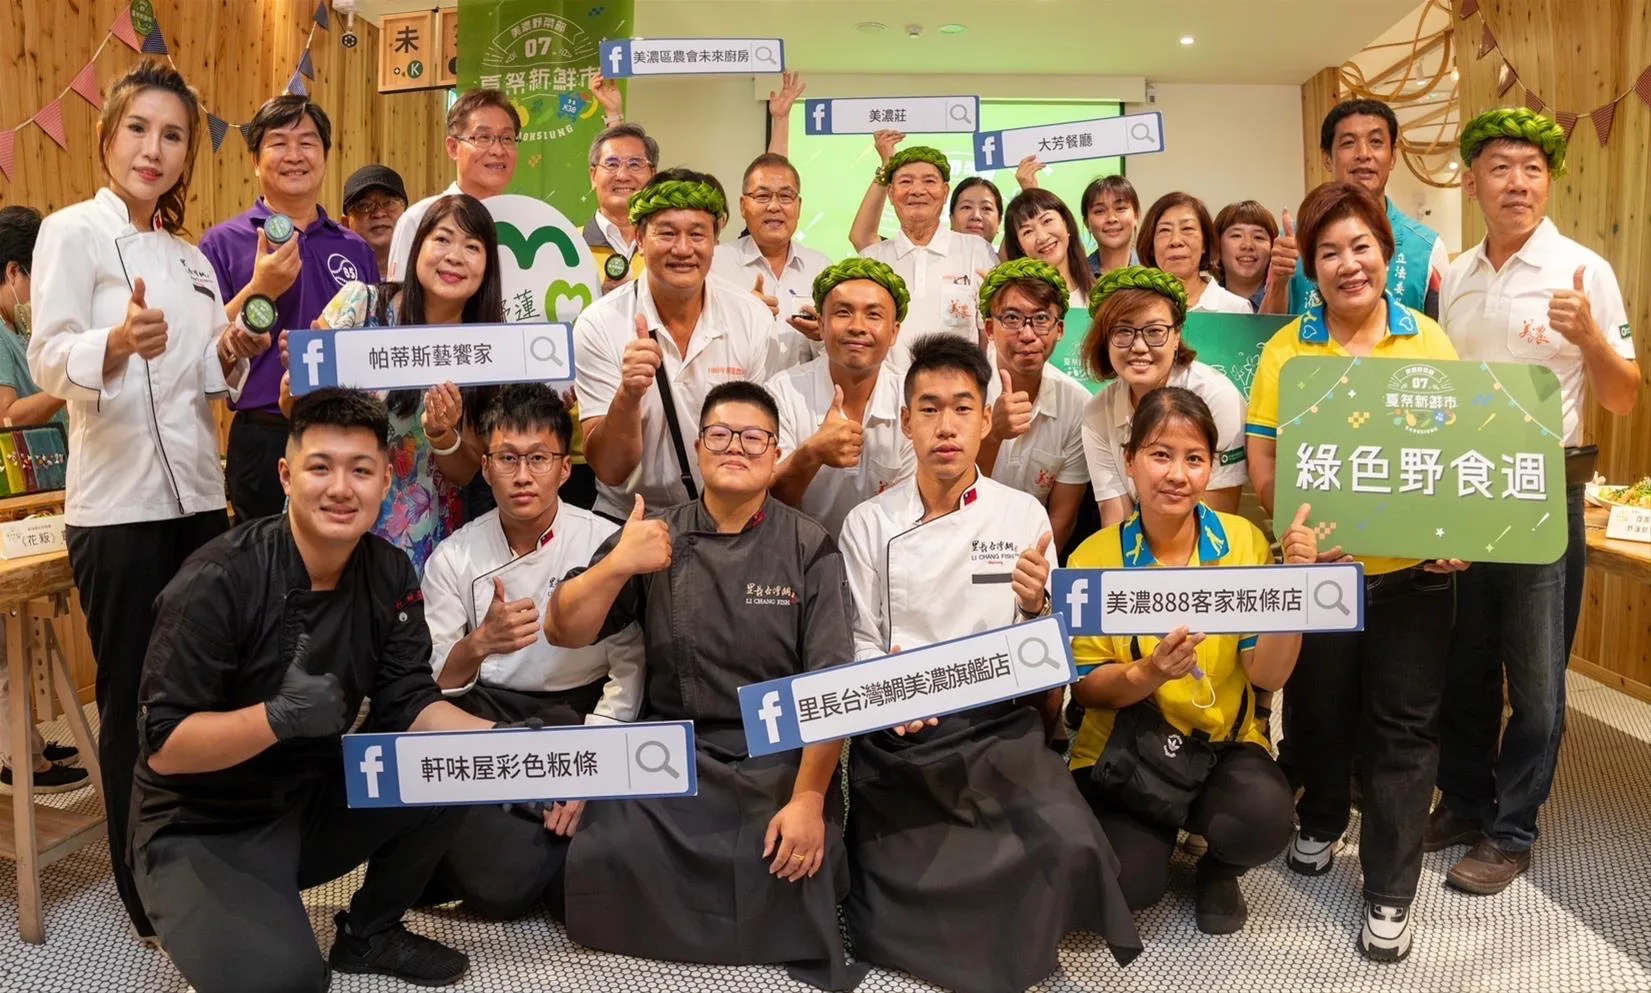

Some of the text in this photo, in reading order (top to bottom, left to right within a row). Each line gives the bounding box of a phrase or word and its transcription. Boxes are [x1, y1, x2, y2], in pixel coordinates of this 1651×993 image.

[394, 26, 419, 53] 未
[525, 37, 552, 58] 07
[410, 63, 420, 76] K
[608, 46, 749, 73] f 美濃區農會未來廚房
[812, 103, 907, 131] f 美濃莊
[981, 132, 1093, 165] f 大芳餐廳
[302, 338, 493, 386] f 帕蒂斯藝饗家
[1412, 377, 1429, 389] 07
[1296, 442, 1547, 500] 綠色野食週
[1066, 578, 1302, 628] f 美濃888客家粄條店
[758, 653, 1011, 744] f 里長台灣鯛美濃旗艦店
[360, 745, 599, 798] f 軒味屋彩色粄條
